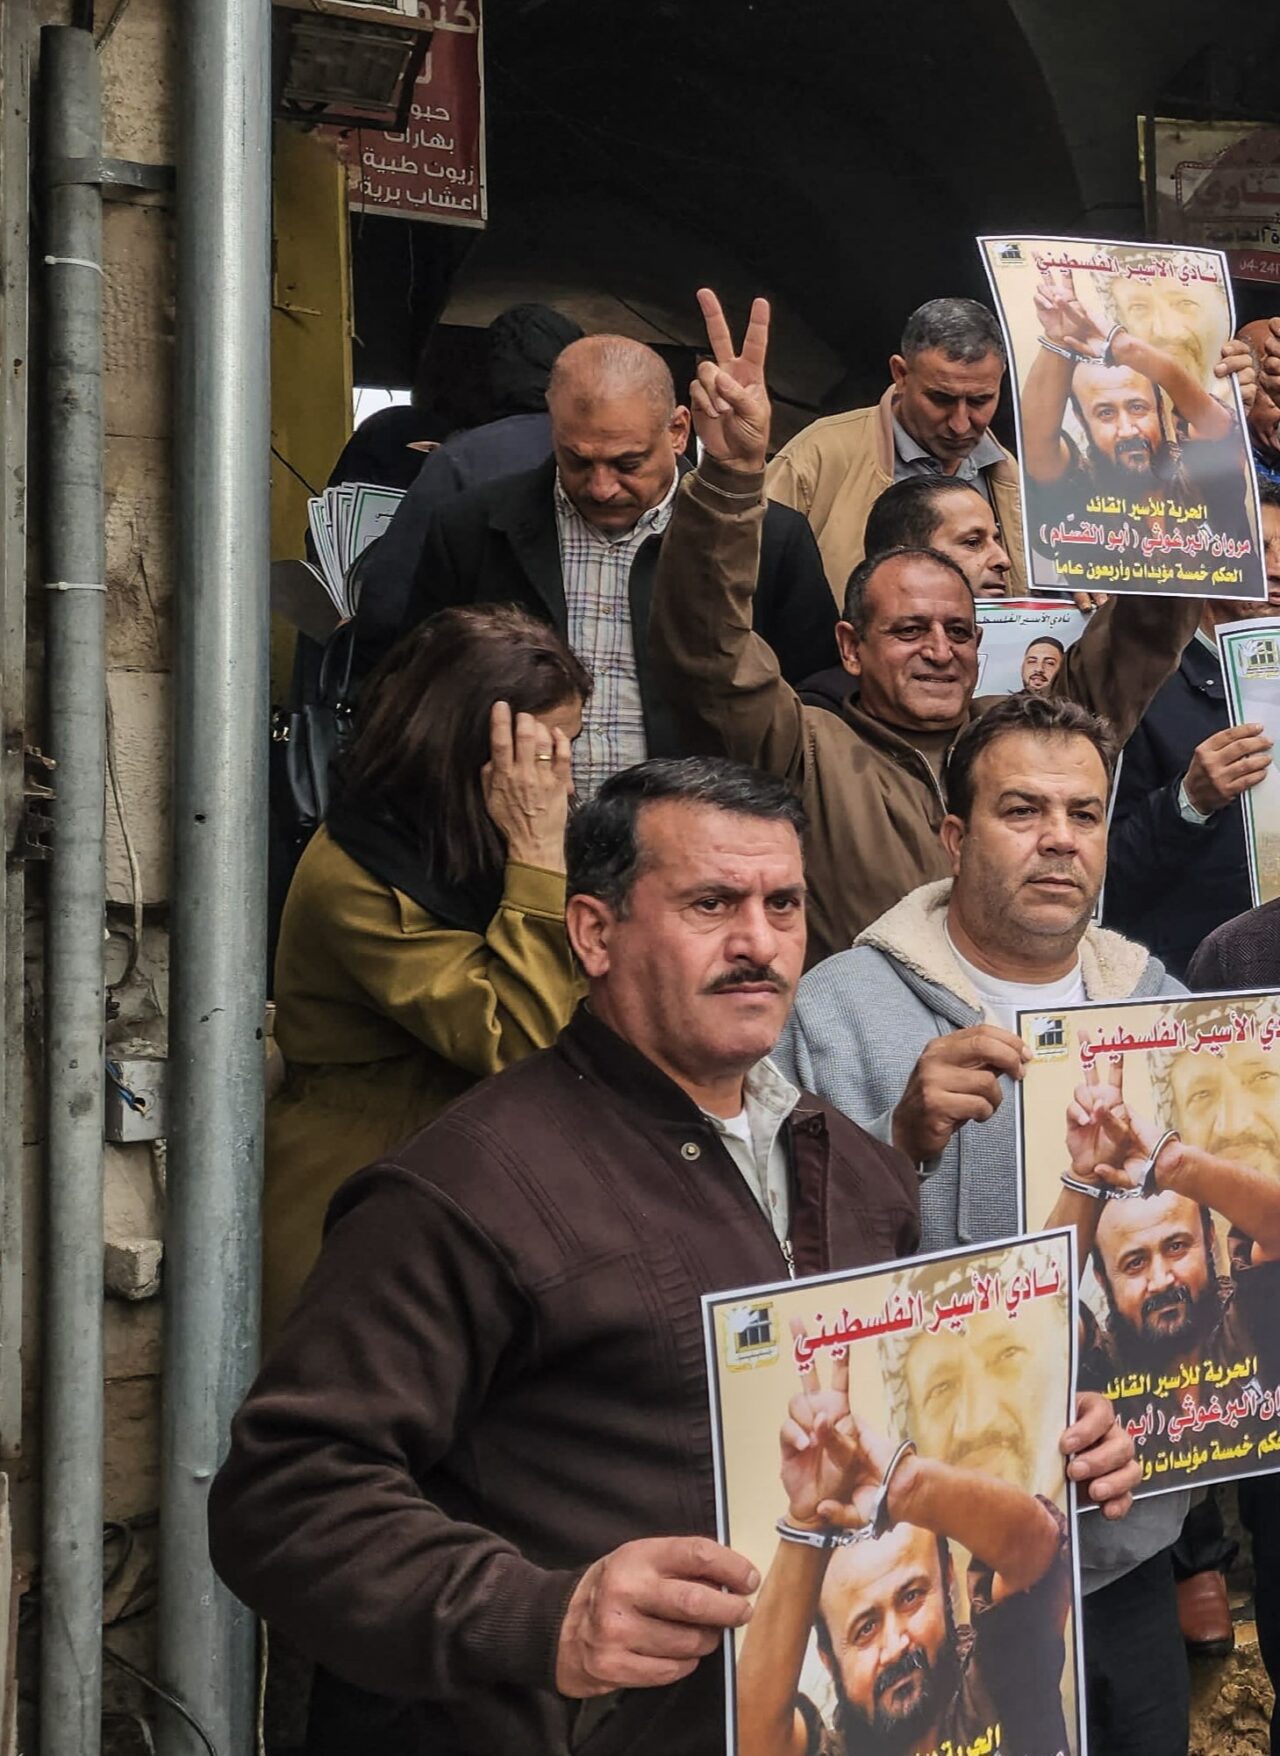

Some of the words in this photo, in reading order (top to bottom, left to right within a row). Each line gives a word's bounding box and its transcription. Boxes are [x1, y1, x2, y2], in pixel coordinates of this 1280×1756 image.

[411, 103, 450, 121] حبو
[384, 128, 454, 154] بهارات
[362, 147, 418, 174] طبية
[361, 176, 400, 205] برية
[406, 186, 477, 210] اعشاب
[1036, 253, 1119, 276] الفلسطيني
[1124, 258, 1175, 286] الأسير
[1179, 264, 1218, 286] نادي
[1086, 496, 1126, 513] القائد
[1129, 497, 1166, 520] للأسير
[1169, 499, 1207, 523] الحرية
[1142, 523, 1210, 557] البرغوثي
[1211, 533, 1251, 558] مروان
[1086, 559, 1131, 582] وأربعون
[1133, 561, 1174, 584] مؤبدات
[1176, 563, 1208, 580] خمسة
[1211, 567, 1243, 586] الحكم
[975, 613, 1021, 624] الفلسط
[1050, 613, 1071, 628] نادي
[1079, 1020, 1187, 1069] الفلسطيني
[1190, 1011, 1256, 1053] الأسير
[928, 1270, 1000, 1333] الأسير
[1005, 1259, 1062, 1319] نادي
[793, 1291, 924, 1372] الفلسطيني
[1154, 1363, 1200, 1398] للأسير
[1204, 1355, 1258, 1389] الحرية
[1102, 1374, 1151, 1400] القائد
[1167, 1393, 1259, 1442] البرغوثي
[1211, 1434, 1254, 1460] خمسة
[1154, 1448, 1208, 1474] مؤبدات
